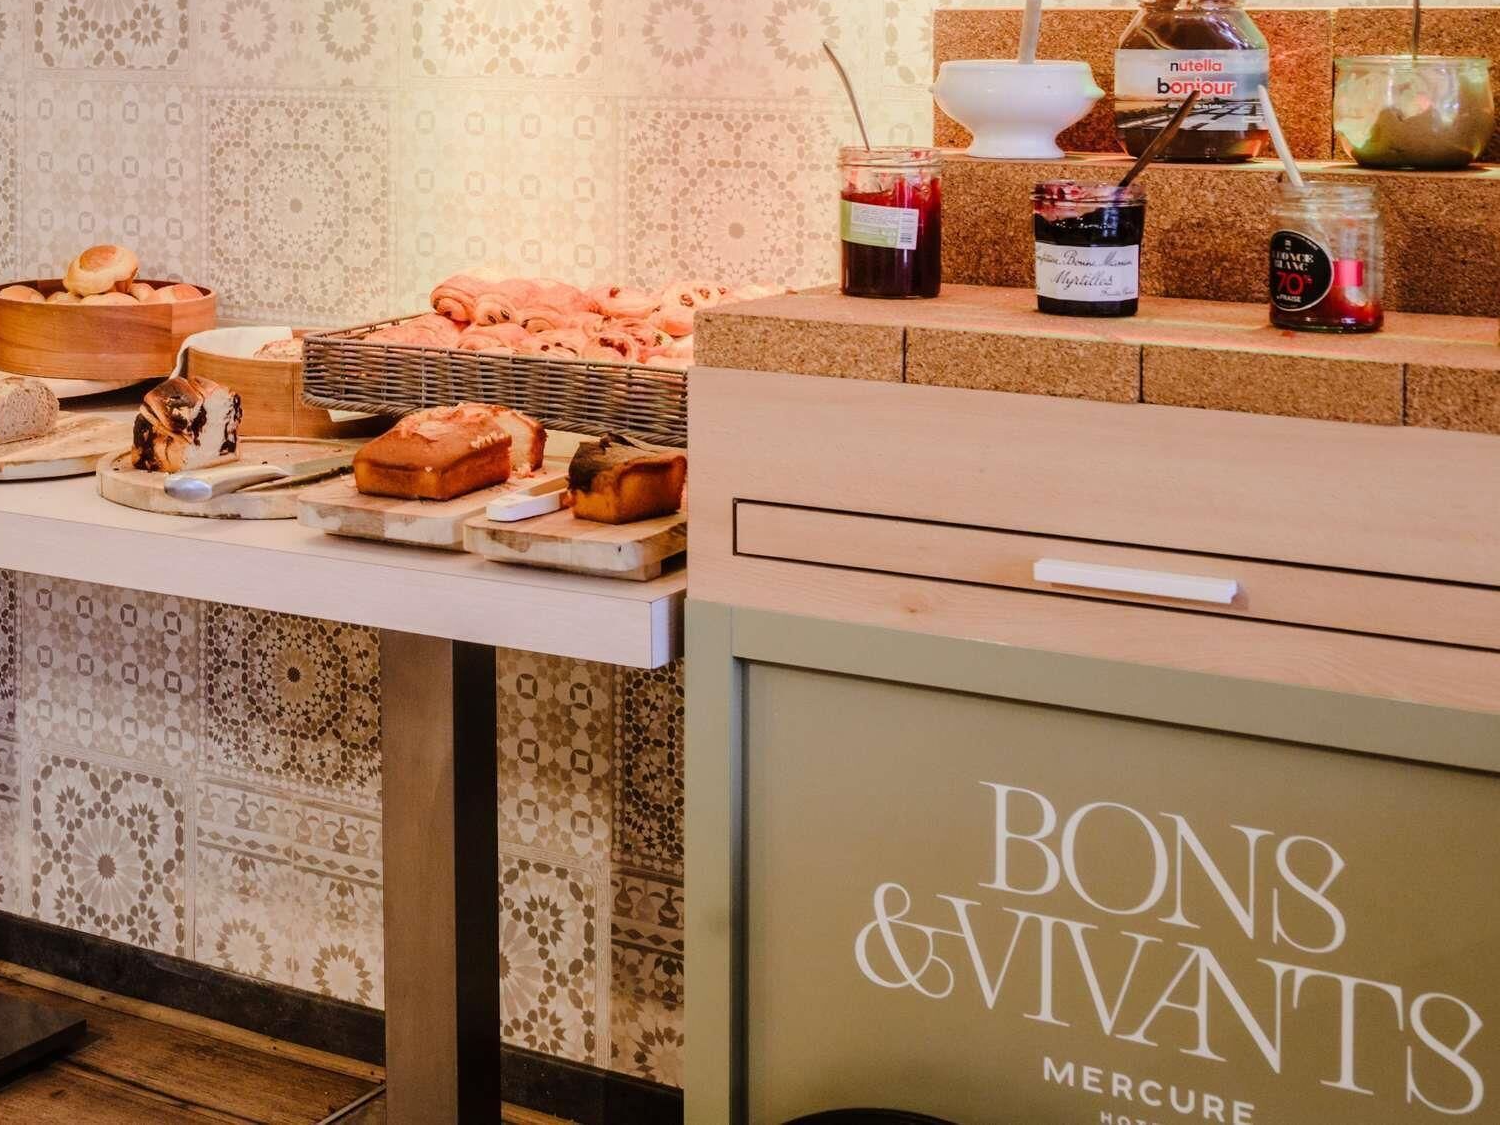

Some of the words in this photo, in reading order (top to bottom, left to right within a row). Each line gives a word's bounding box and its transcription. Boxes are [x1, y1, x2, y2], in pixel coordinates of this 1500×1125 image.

[1157, 77, 1235, 99] bonjour
[1170, 59, 1222, 72] nutella
[978, 781, 1347, 954] BONS
[1043, 1056, 1255, 1125] MERCURE
